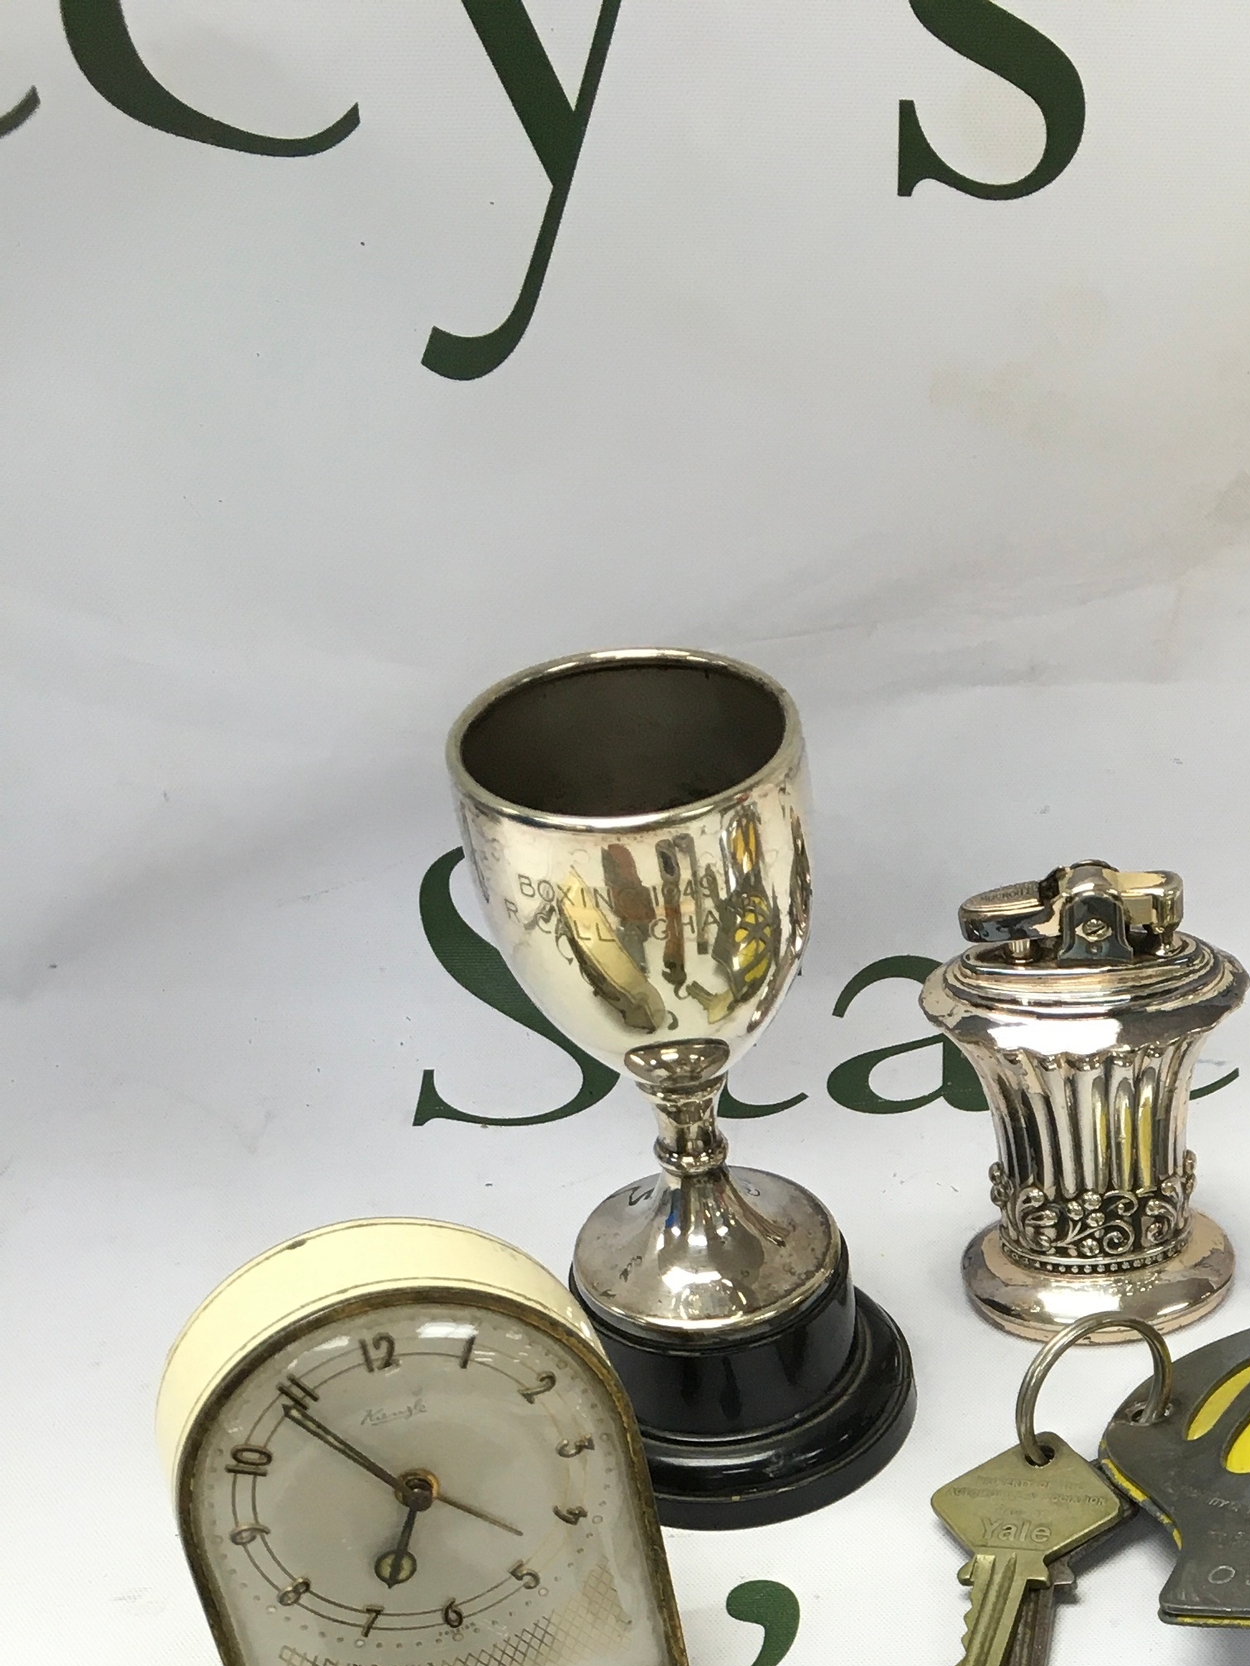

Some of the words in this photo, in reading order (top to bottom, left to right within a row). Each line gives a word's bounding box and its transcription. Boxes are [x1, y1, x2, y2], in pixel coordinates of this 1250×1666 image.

[517, 872, 648, 911] BOXING
[359, 1332, 398, 1373] 12
[459, 1336, 476, 1370] 1
[276, 1373, 320, 1411] 11
[518, 1371, 557, 1404] 2
[225, 1444, 274, 1478] 10
[556, 1434, 595, 1459] 3
[552, 1504, 589, 1526] 4
[981, 1517, 1052, 1543] Yale
[230, 1524, 272, 1547] 9
[508, 1558, 541, 1591] 5
[277, 1576, 312, 1607] 8
[361, 1606, 385, 1639] 7
[443, 1596, 464, 1629] 6
